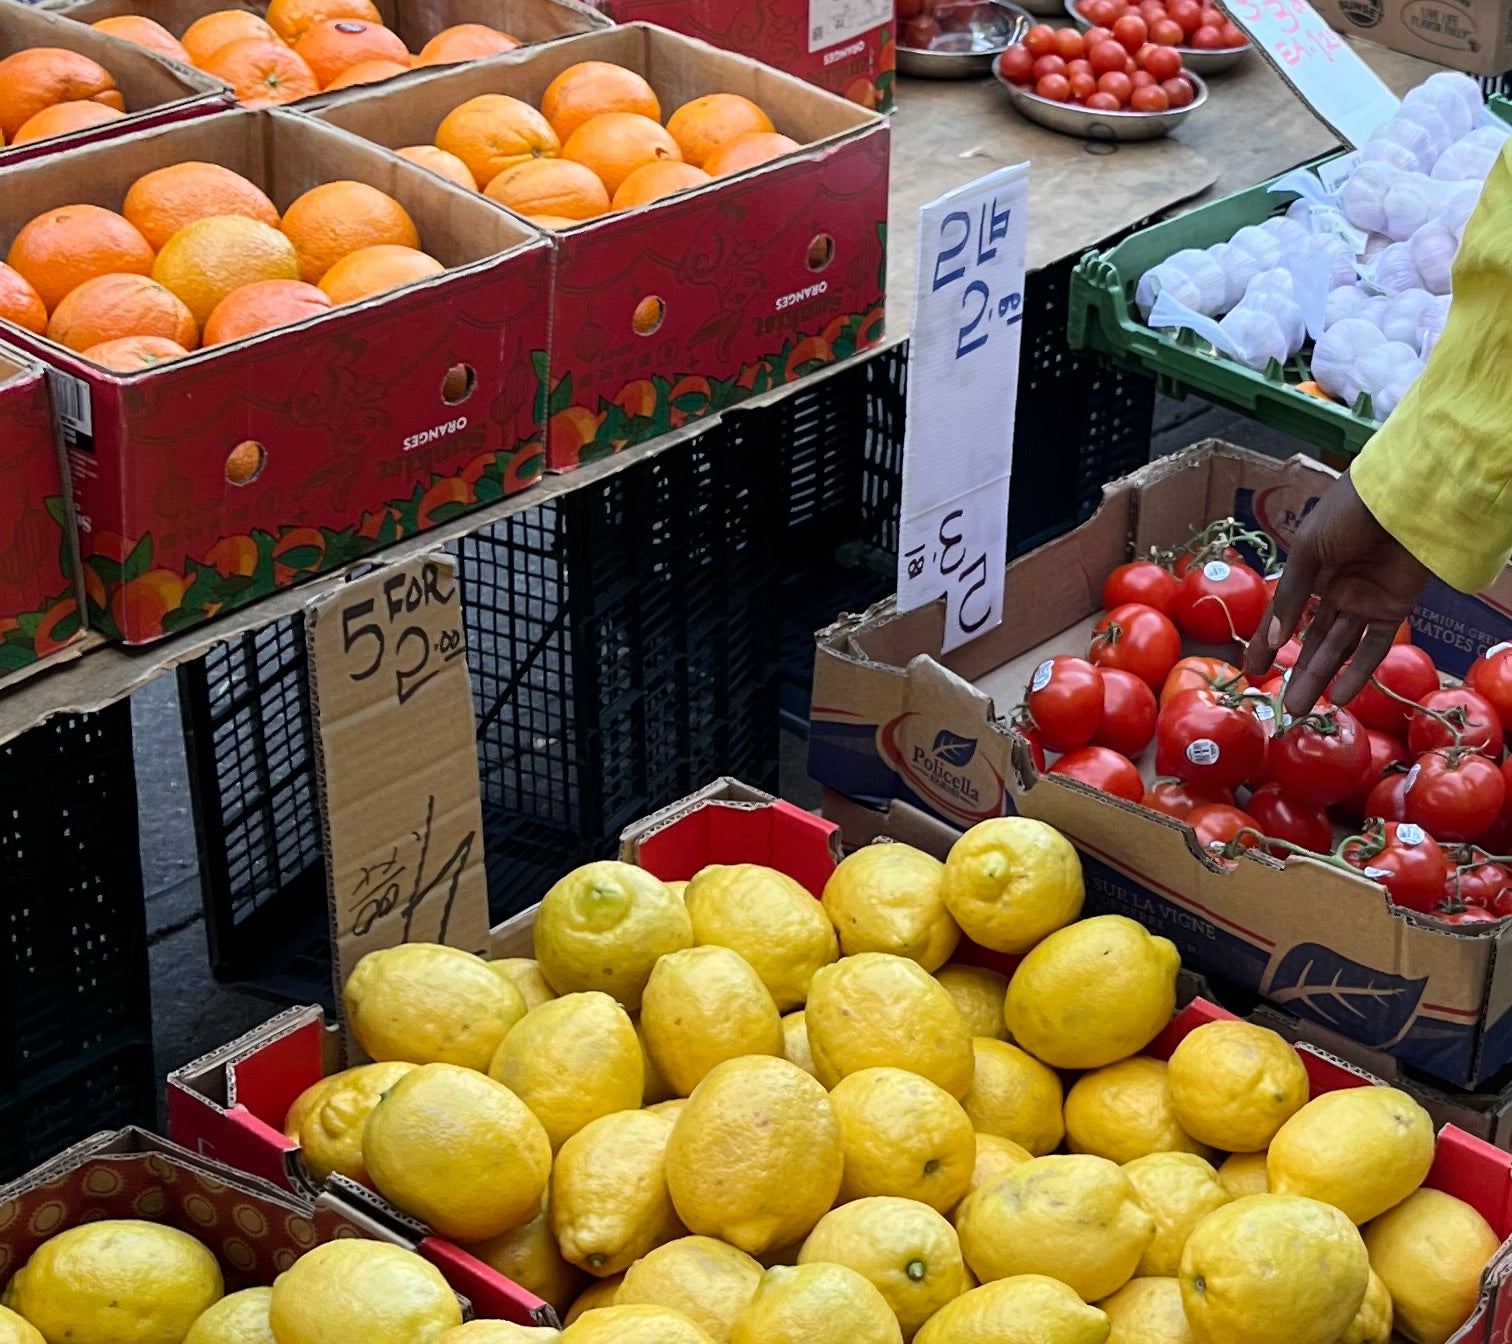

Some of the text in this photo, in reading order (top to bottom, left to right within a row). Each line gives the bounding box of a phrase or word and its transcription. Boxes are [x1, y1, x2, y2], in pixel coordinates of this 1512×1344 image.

[932, 211, 971, 293] 2
[776, 280, 828, 311] ORANGES
[403, 416, 468, 451] ORANGES
[341, 563, 455, 682] 5 FOR
[1410, 614, 1474, 654] MATOES
[1414, 607, 1465, 635] REMIUM
[912, 745, 979, 803] Policella
[1130, 893, 1155, 914] LA
[1160, 905, 1217, 940] VIGNE
